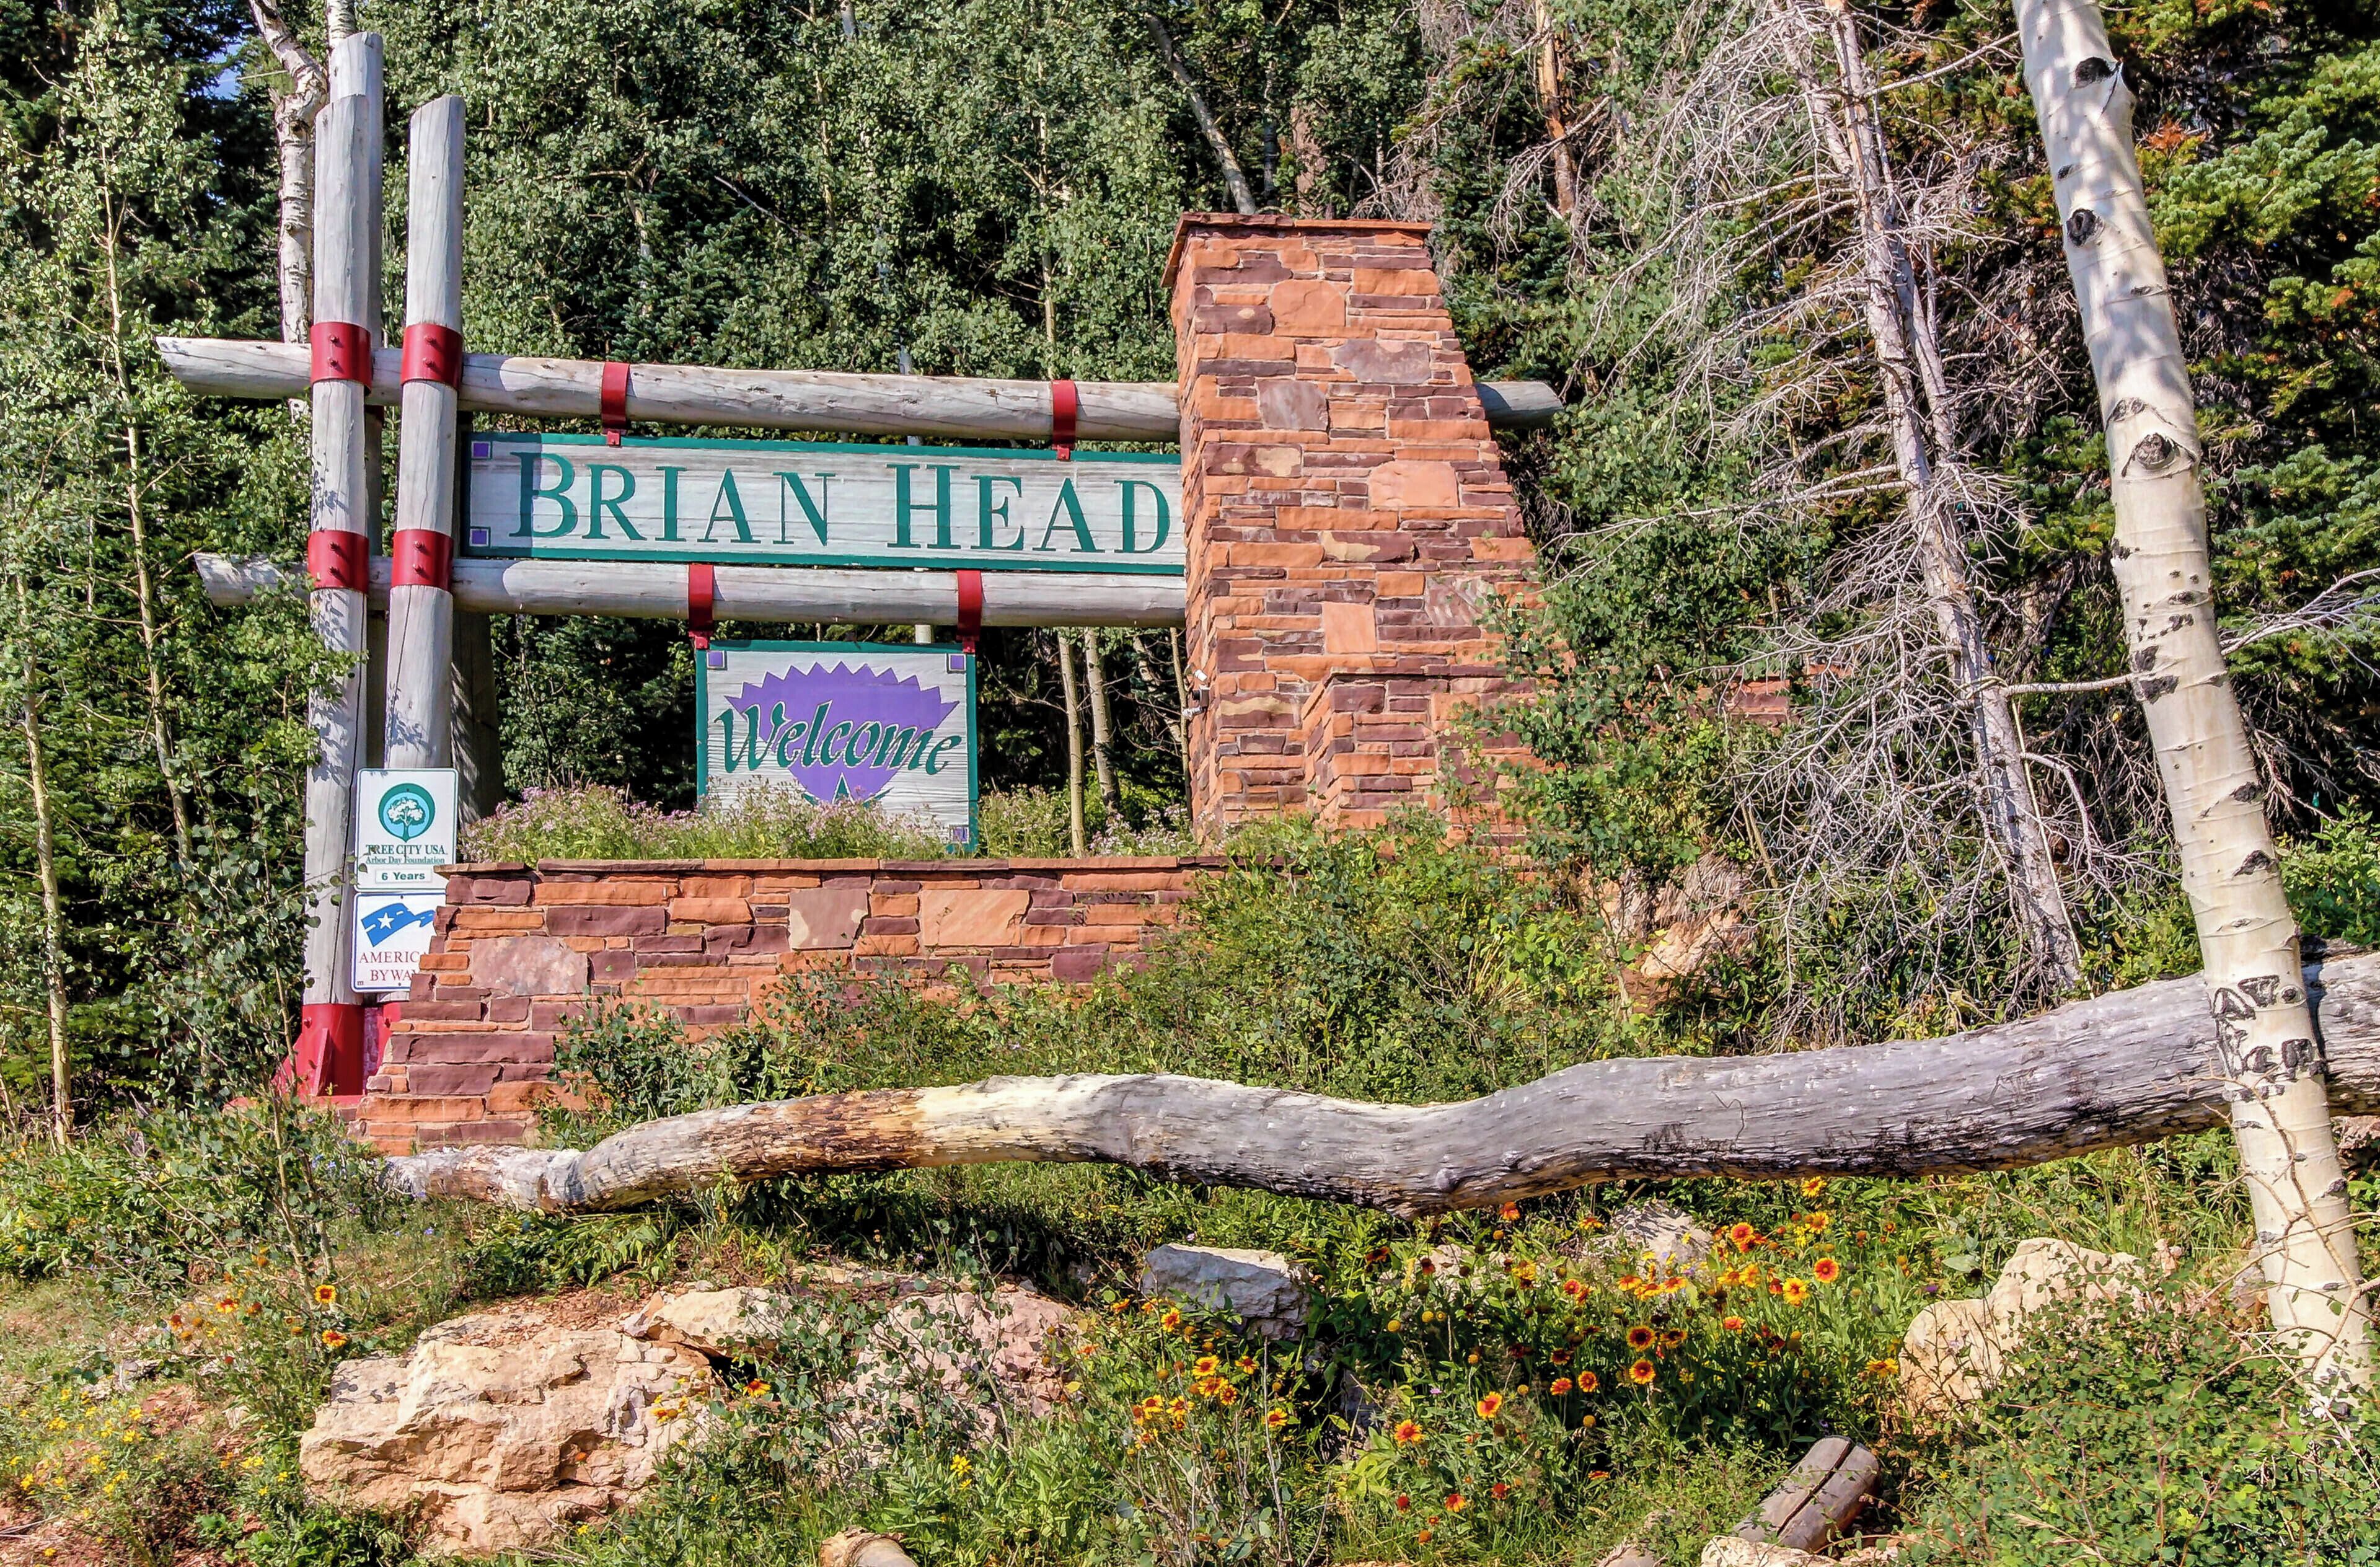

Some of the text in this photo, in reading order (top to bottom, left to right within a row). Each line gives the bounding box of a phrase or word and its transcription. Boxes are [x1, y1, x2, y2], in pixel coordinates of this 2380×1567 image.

[508, 451, 1170, 554] BRIAN HEAD
[713, 700, 963, 775] Welcome
[366, 844, 446, 855] TREE CITY USA
[366, 856, 445, 865] Arbor Day Foundation
[381, 872, 425, 880] 6 Years
[359, 951, 426, 963] AMERIC
